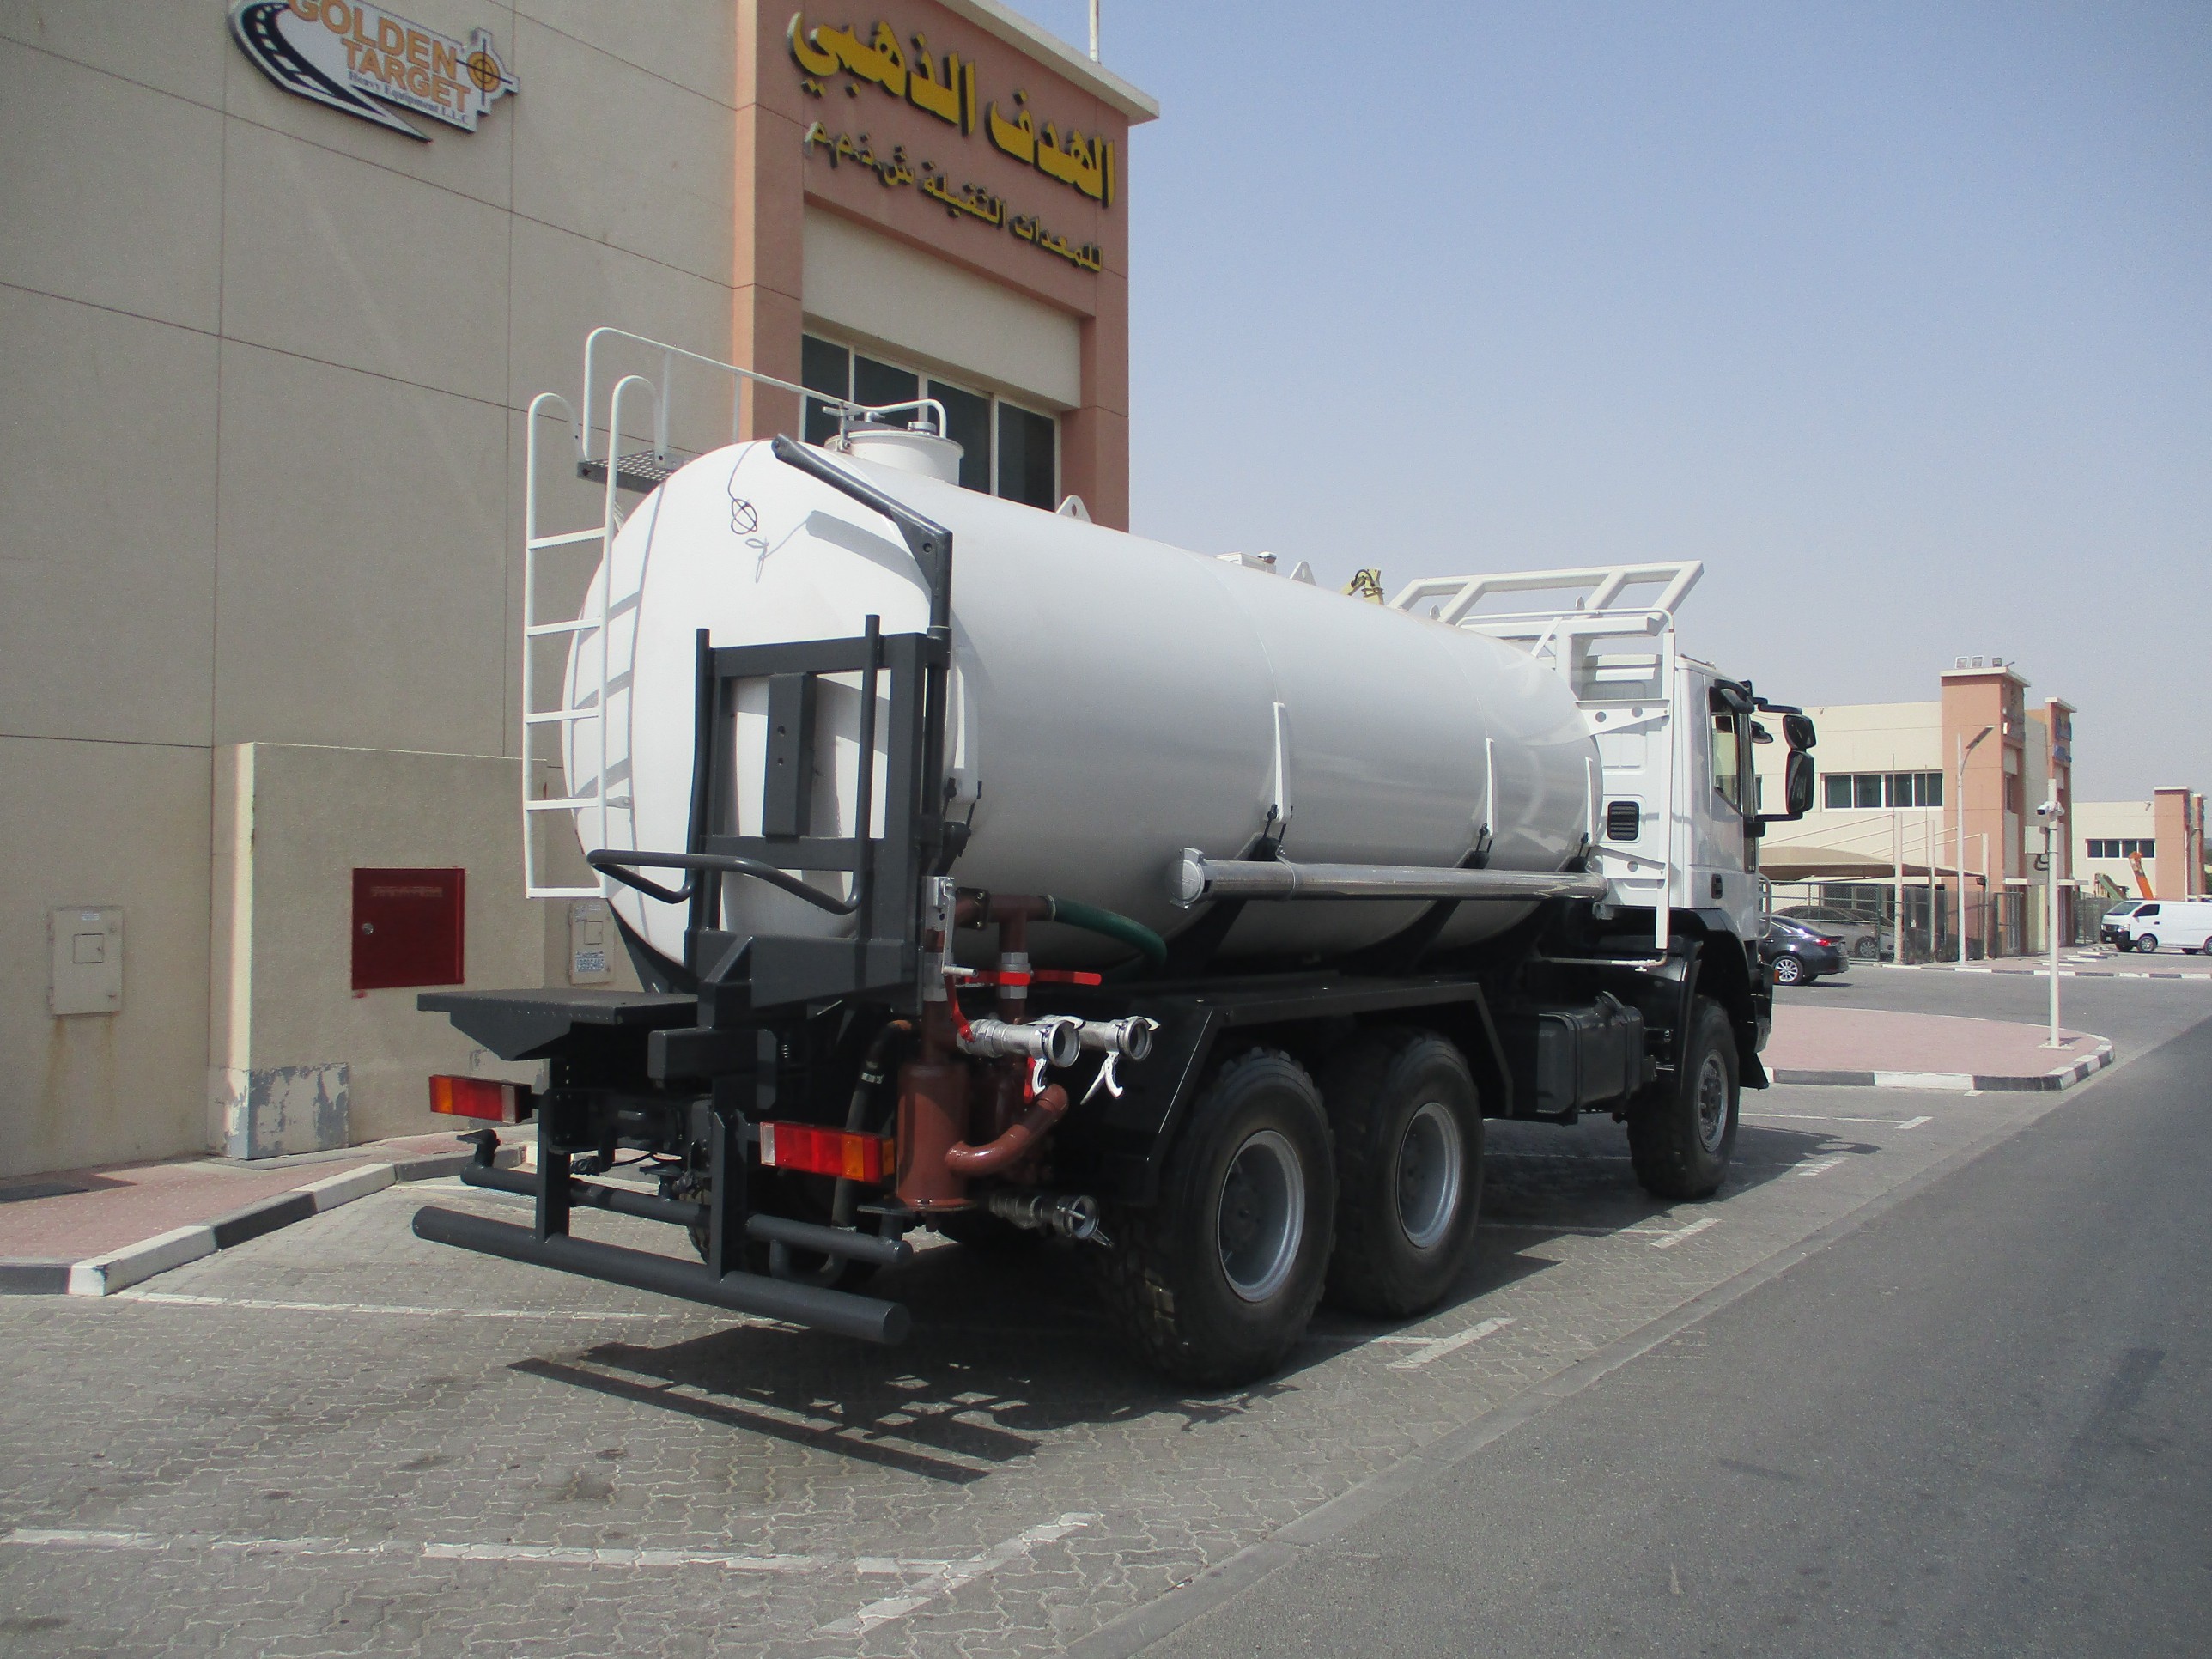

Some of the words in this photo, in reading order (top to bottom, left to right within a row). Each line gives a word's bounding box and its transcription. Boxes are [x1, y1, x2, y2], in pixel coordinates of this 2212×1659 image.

[288, 0, 458, 81] GOLDEN
[340, 38, 471, 113] TARGET
[787, 10, 976, 137] الذهبي
[985, 88, 1115, 208] الهدف
[1009, 214, 1103, 273] للمعدات
